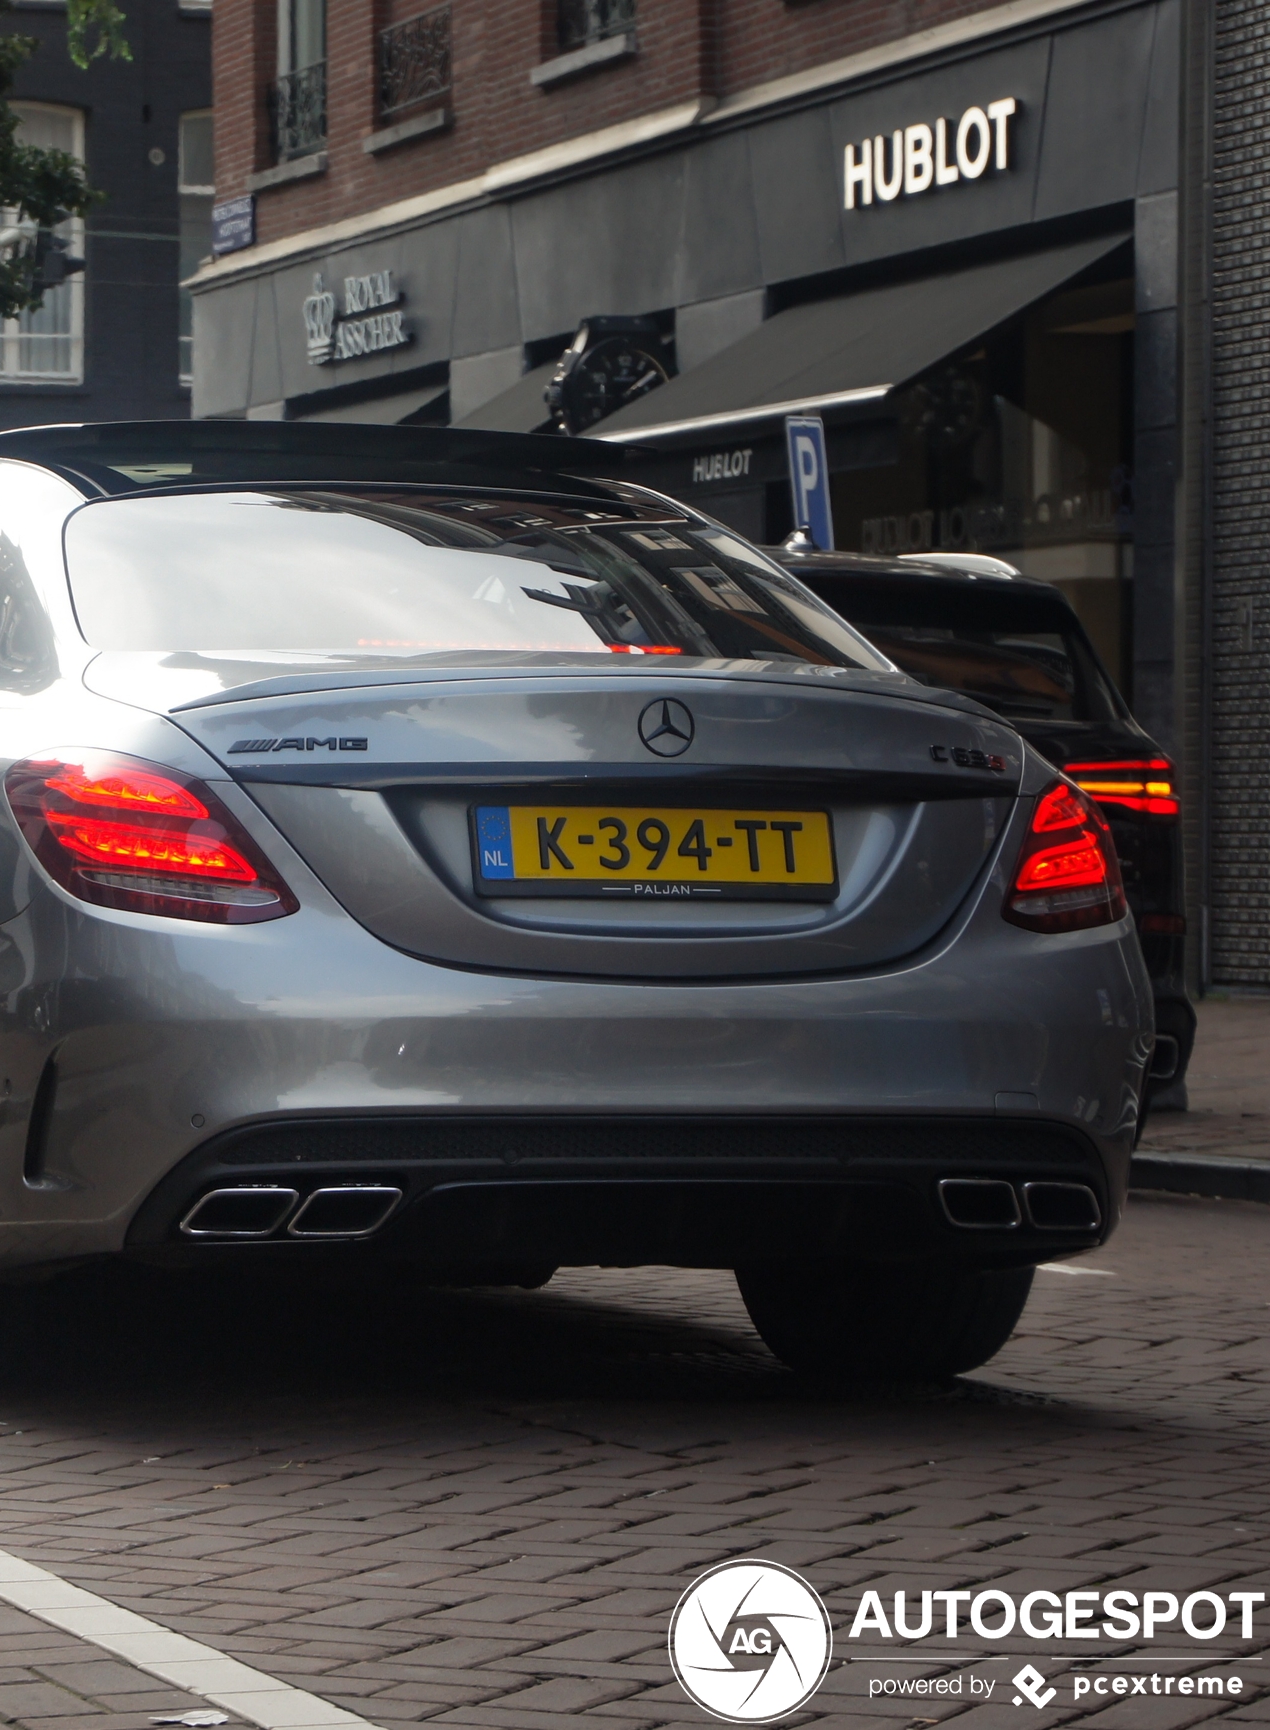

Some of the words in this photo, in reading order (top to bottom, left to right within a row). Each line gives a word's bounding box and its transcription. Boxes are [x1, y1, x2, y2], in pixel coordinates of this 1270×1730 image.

[845, 98, 1014, 209] HUBLOT
[344, 270, 398, 314] ROYAL
[334, 311, 409, 359] ASSCHER
[692, 448, 753, 483] HUBLOT
[796, 436, 819, 522] P
[272, 737, 368, 751] AMG
[484, 850, 508, 867] NL
[536, 816, 803, 873] K-394-TT
[635, 885, 689, 893] PALJAN
